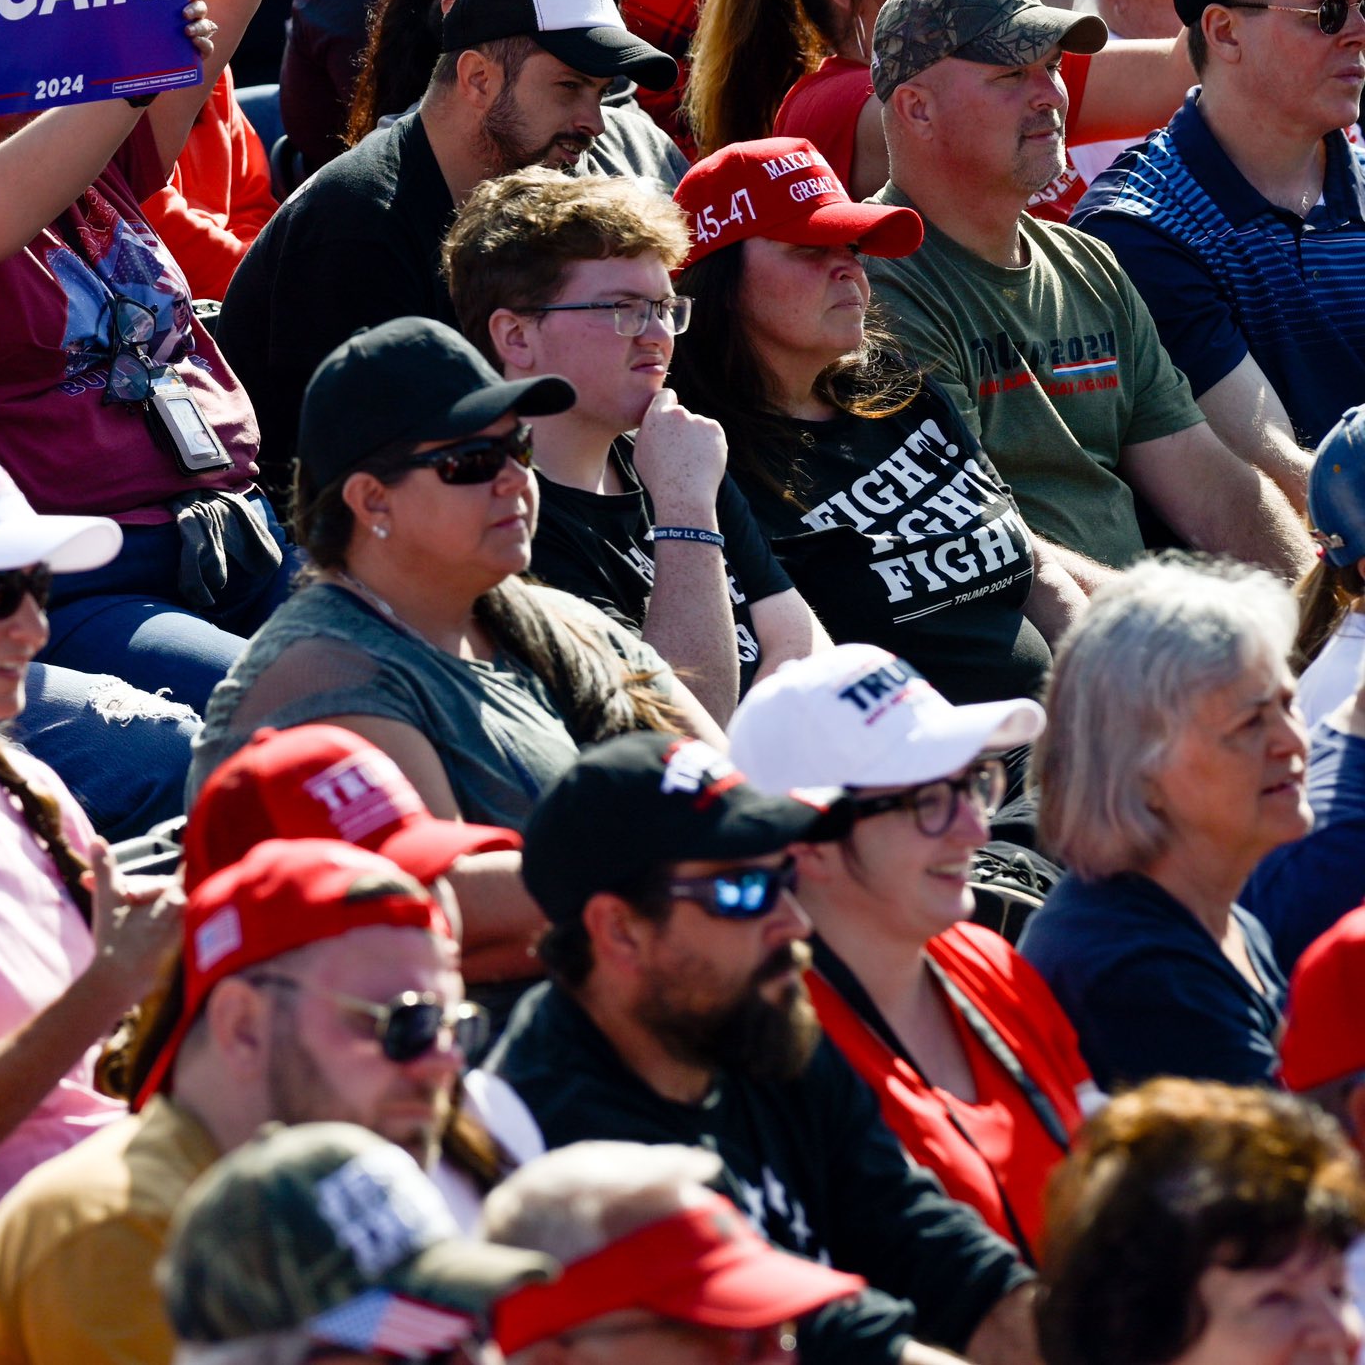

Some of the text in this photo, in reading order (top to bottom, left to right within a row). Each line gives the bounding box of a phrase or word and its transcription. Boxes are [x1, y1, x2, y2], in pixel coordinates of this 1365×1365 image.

[34, 73, 84, 101] 2024
[761, 155, 810, 182] MAKE
[788, 176, 835, 204] GREAT
[696, 187, 757, 244] 45-47
[1050, 330, 1117, 366] 2024
[800, 417, 959, 535] FIGHT!
[669, 528, 682, 539] for
[684, 530, 697, 540] Lt.
[954, 575, 1014, 606] TRUMP 2024
